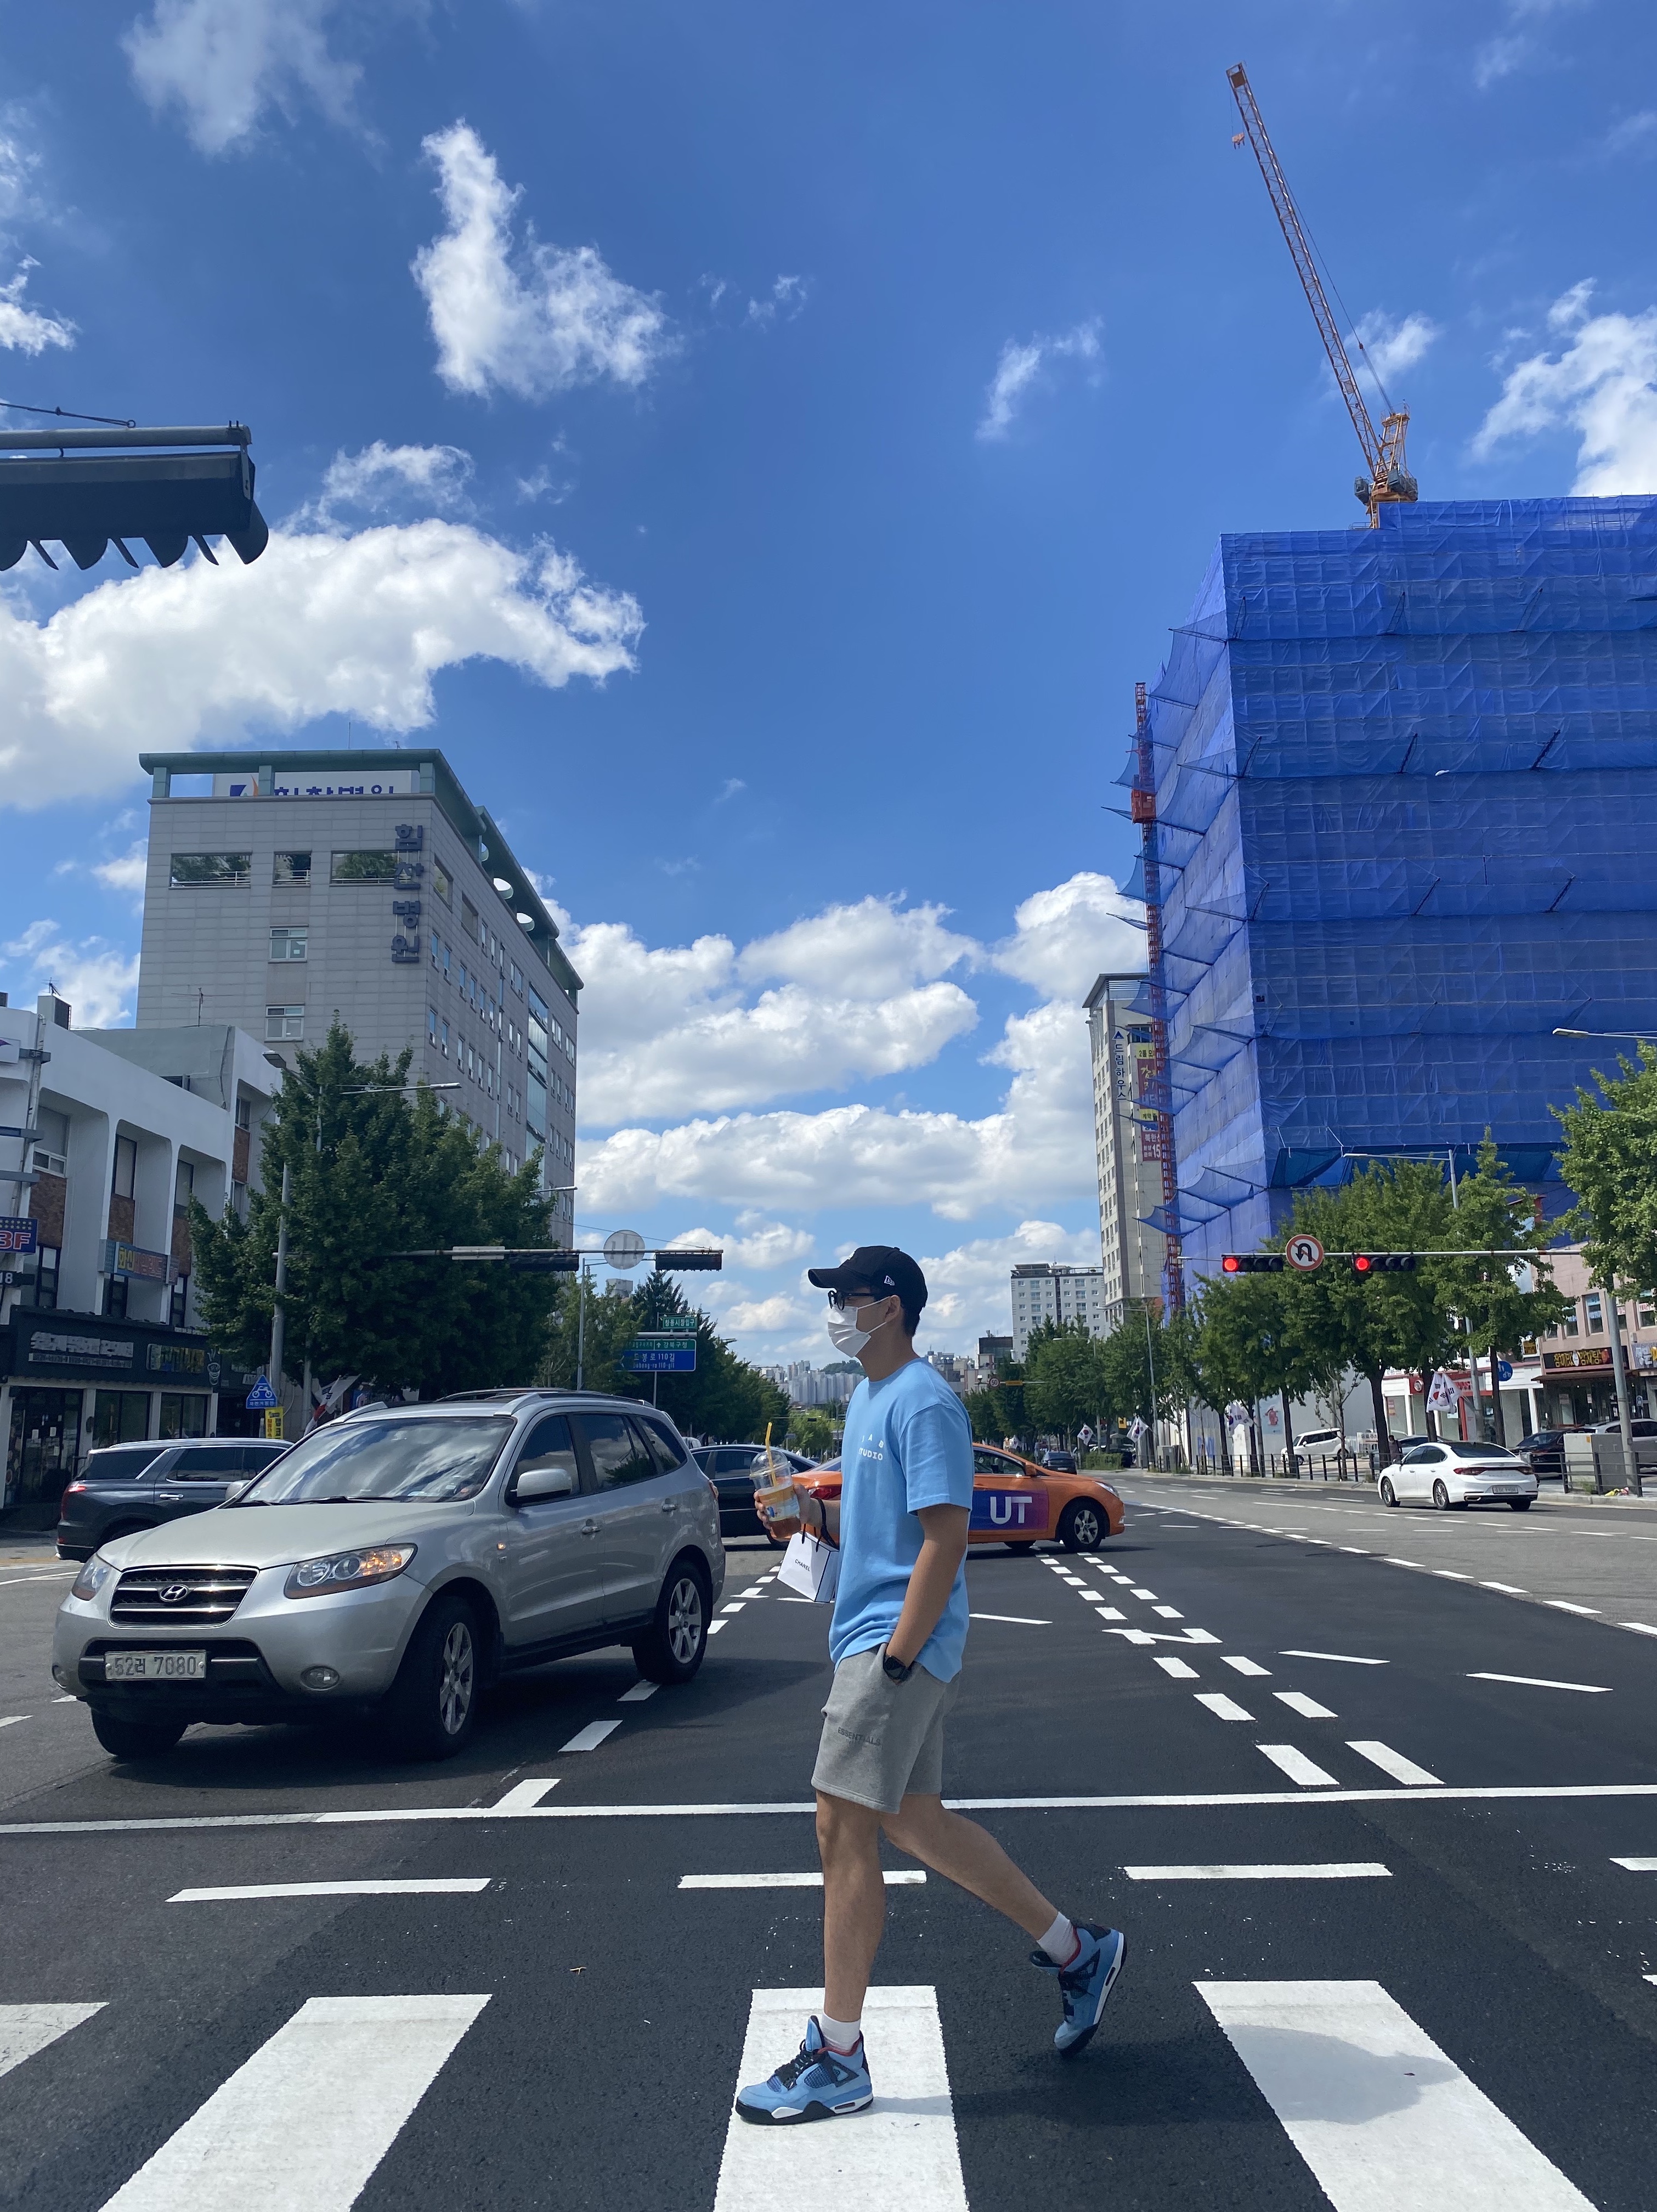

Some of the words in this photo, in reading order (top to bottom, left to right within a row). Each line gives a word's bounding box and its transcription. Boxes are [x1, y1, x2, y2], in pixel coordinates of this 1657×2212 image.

[391, 824, 425, 963] 힘찬병원
[1113, 1043, 1127, 1101] 드림하우스
[0, 1229, 31, 1250] 3F
[664, 1318, 695, 1327] 창동시장입구
[989, 1496, 1033, 1524] UT
[795, 1559, 810, 1572] CHANEL
[114, 1656, 146, 1676] 52러
[154, 1655, 196, 1675] 7080
